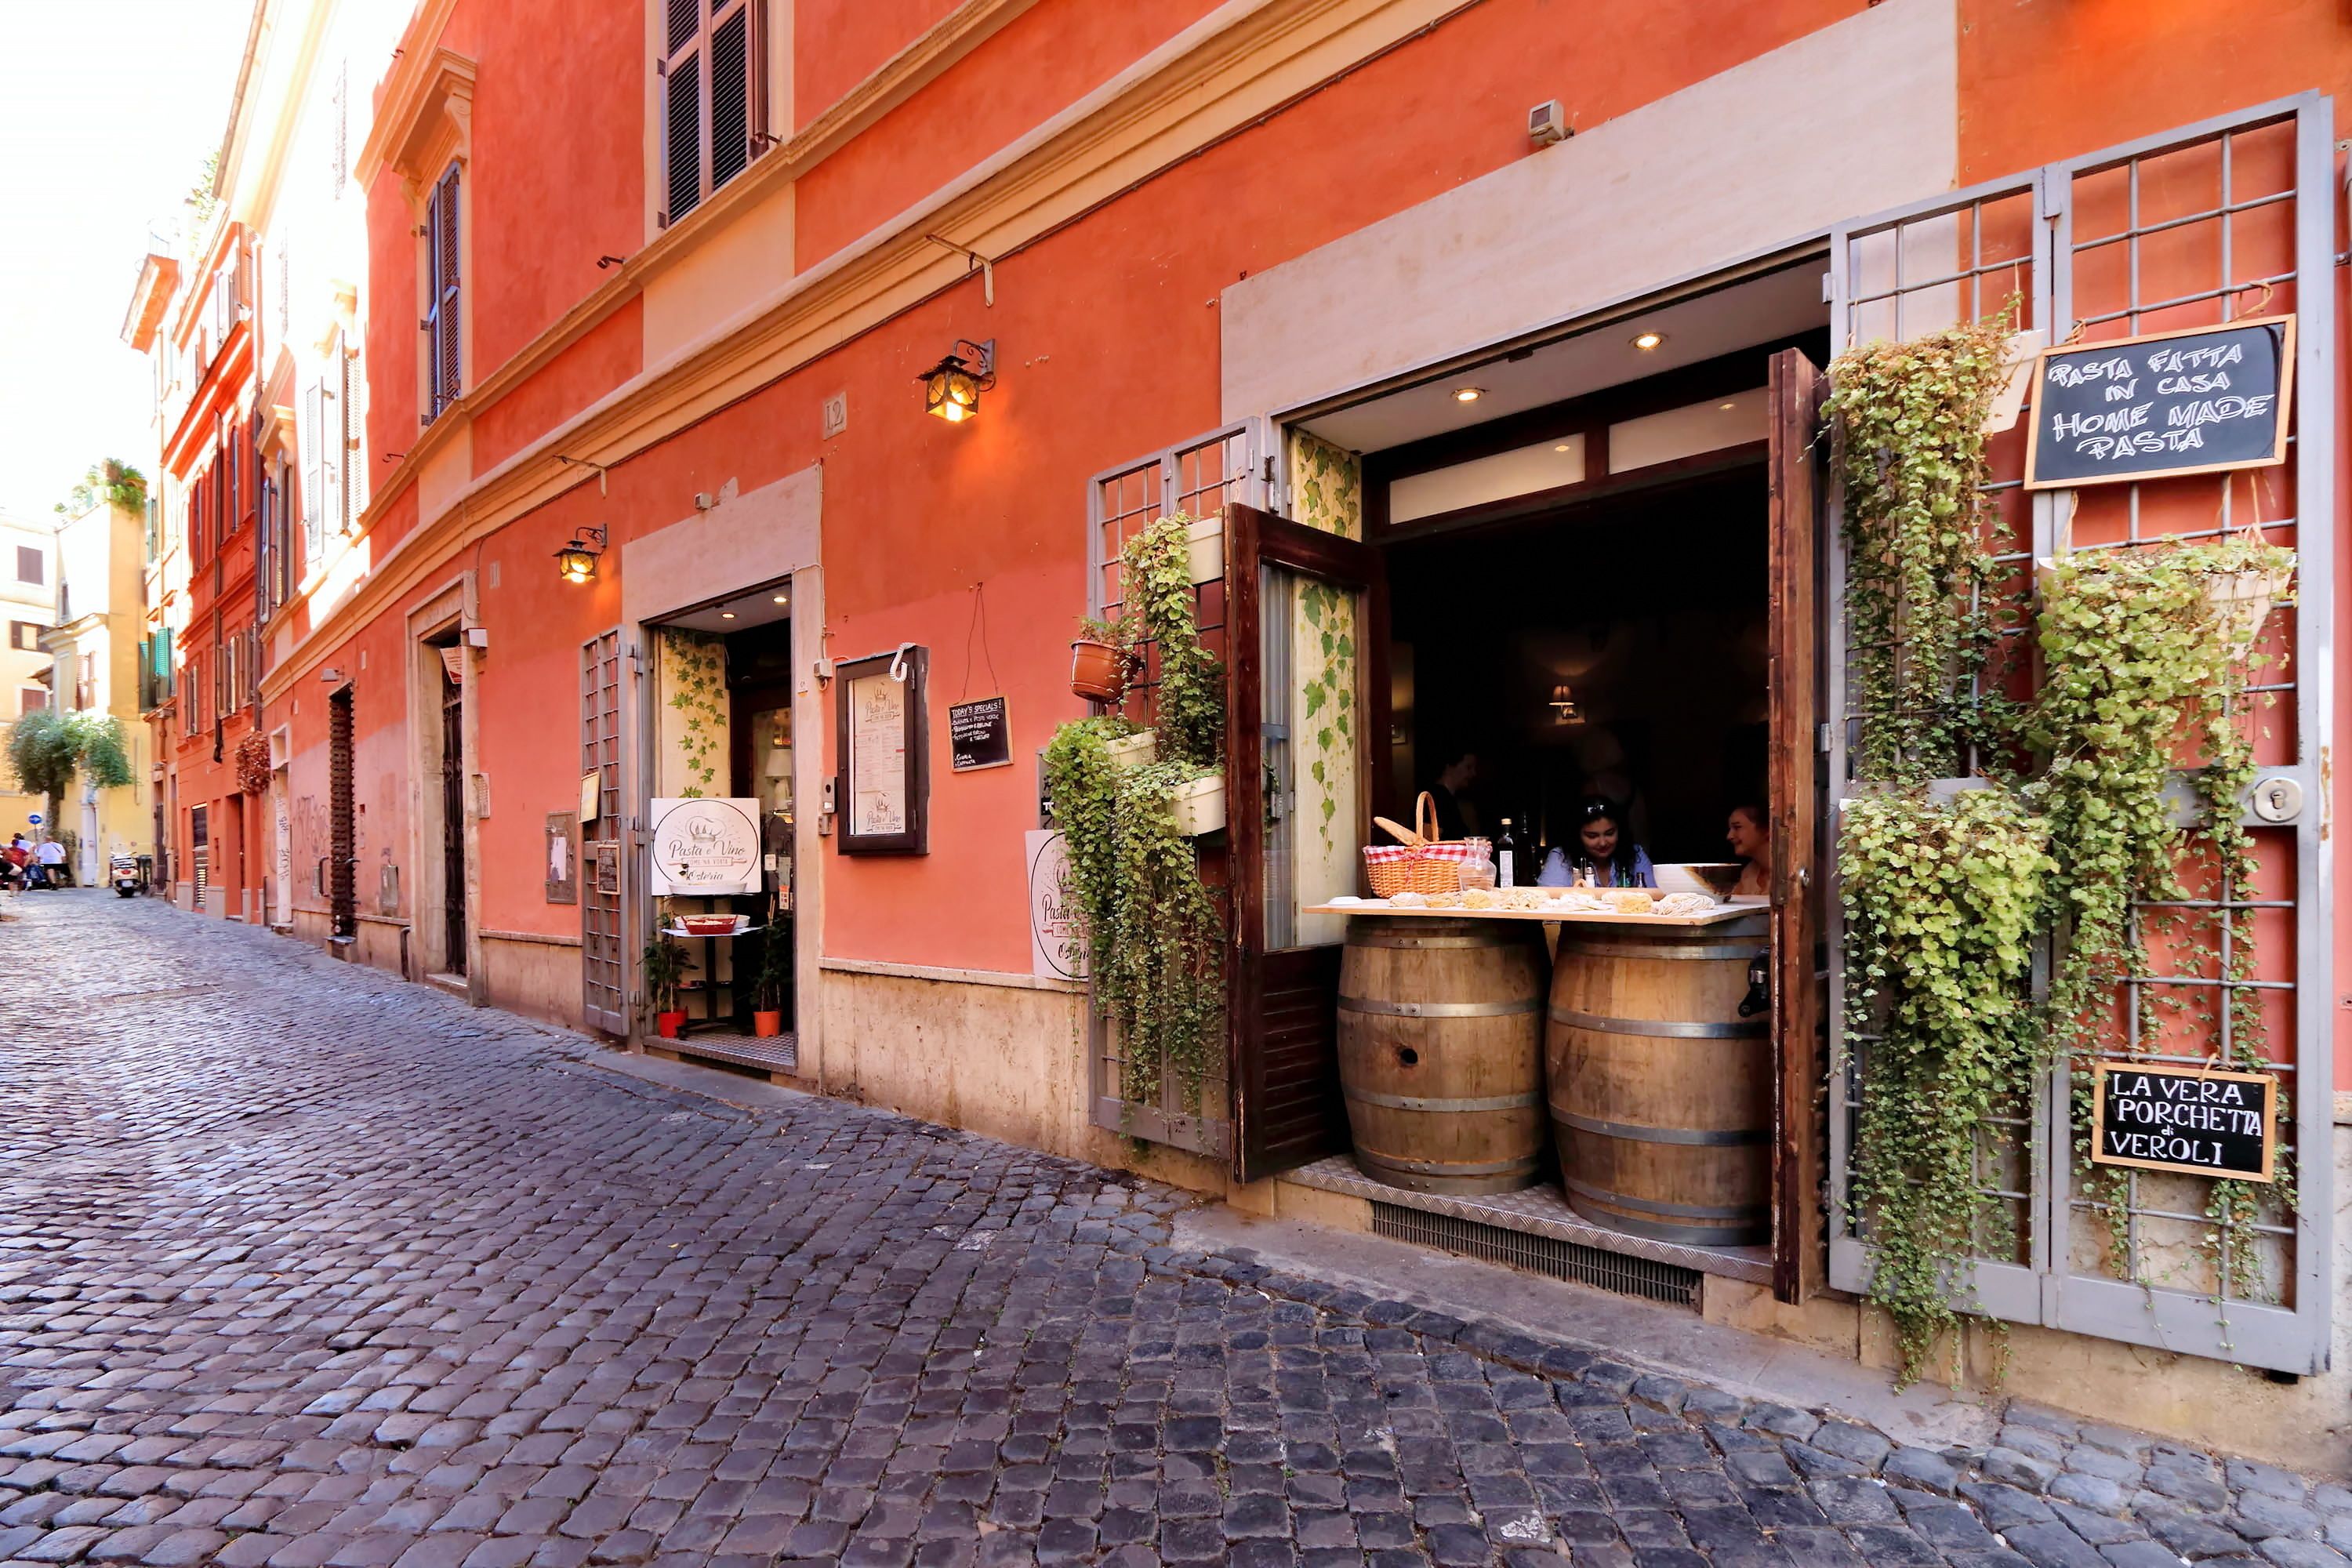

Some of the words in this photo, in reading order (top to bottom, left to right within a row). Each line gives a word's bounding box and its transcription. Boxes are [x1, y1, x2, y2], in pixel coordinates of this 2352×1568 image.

[2048, 358, 2133, 387] PASTA
[2147, 343, 2242, 373] FATTA
[2105, 378, 2139, 401] IN
[2158, 372, 2230, 394] CASA
[2053, 401, 2154, 442] HOME
[2168, 394, 2275, 428] MADE
[2076, 428, 2204, 460] PASTA
[669, 840, 702, 858] Pasta
[713, 840, 745, 855] Vino
[1042, 894, 1069, 922] Pasta
[2114, 1073, 2151, 1096] LA
[2159, 1078, 2244, 1105] VERA
[2118, 1098, 2263, 1137] PORCHETTA
[2161, 1125, 2174, 1136] di
[2111, 1131, 2223, 1165] VEROLI
